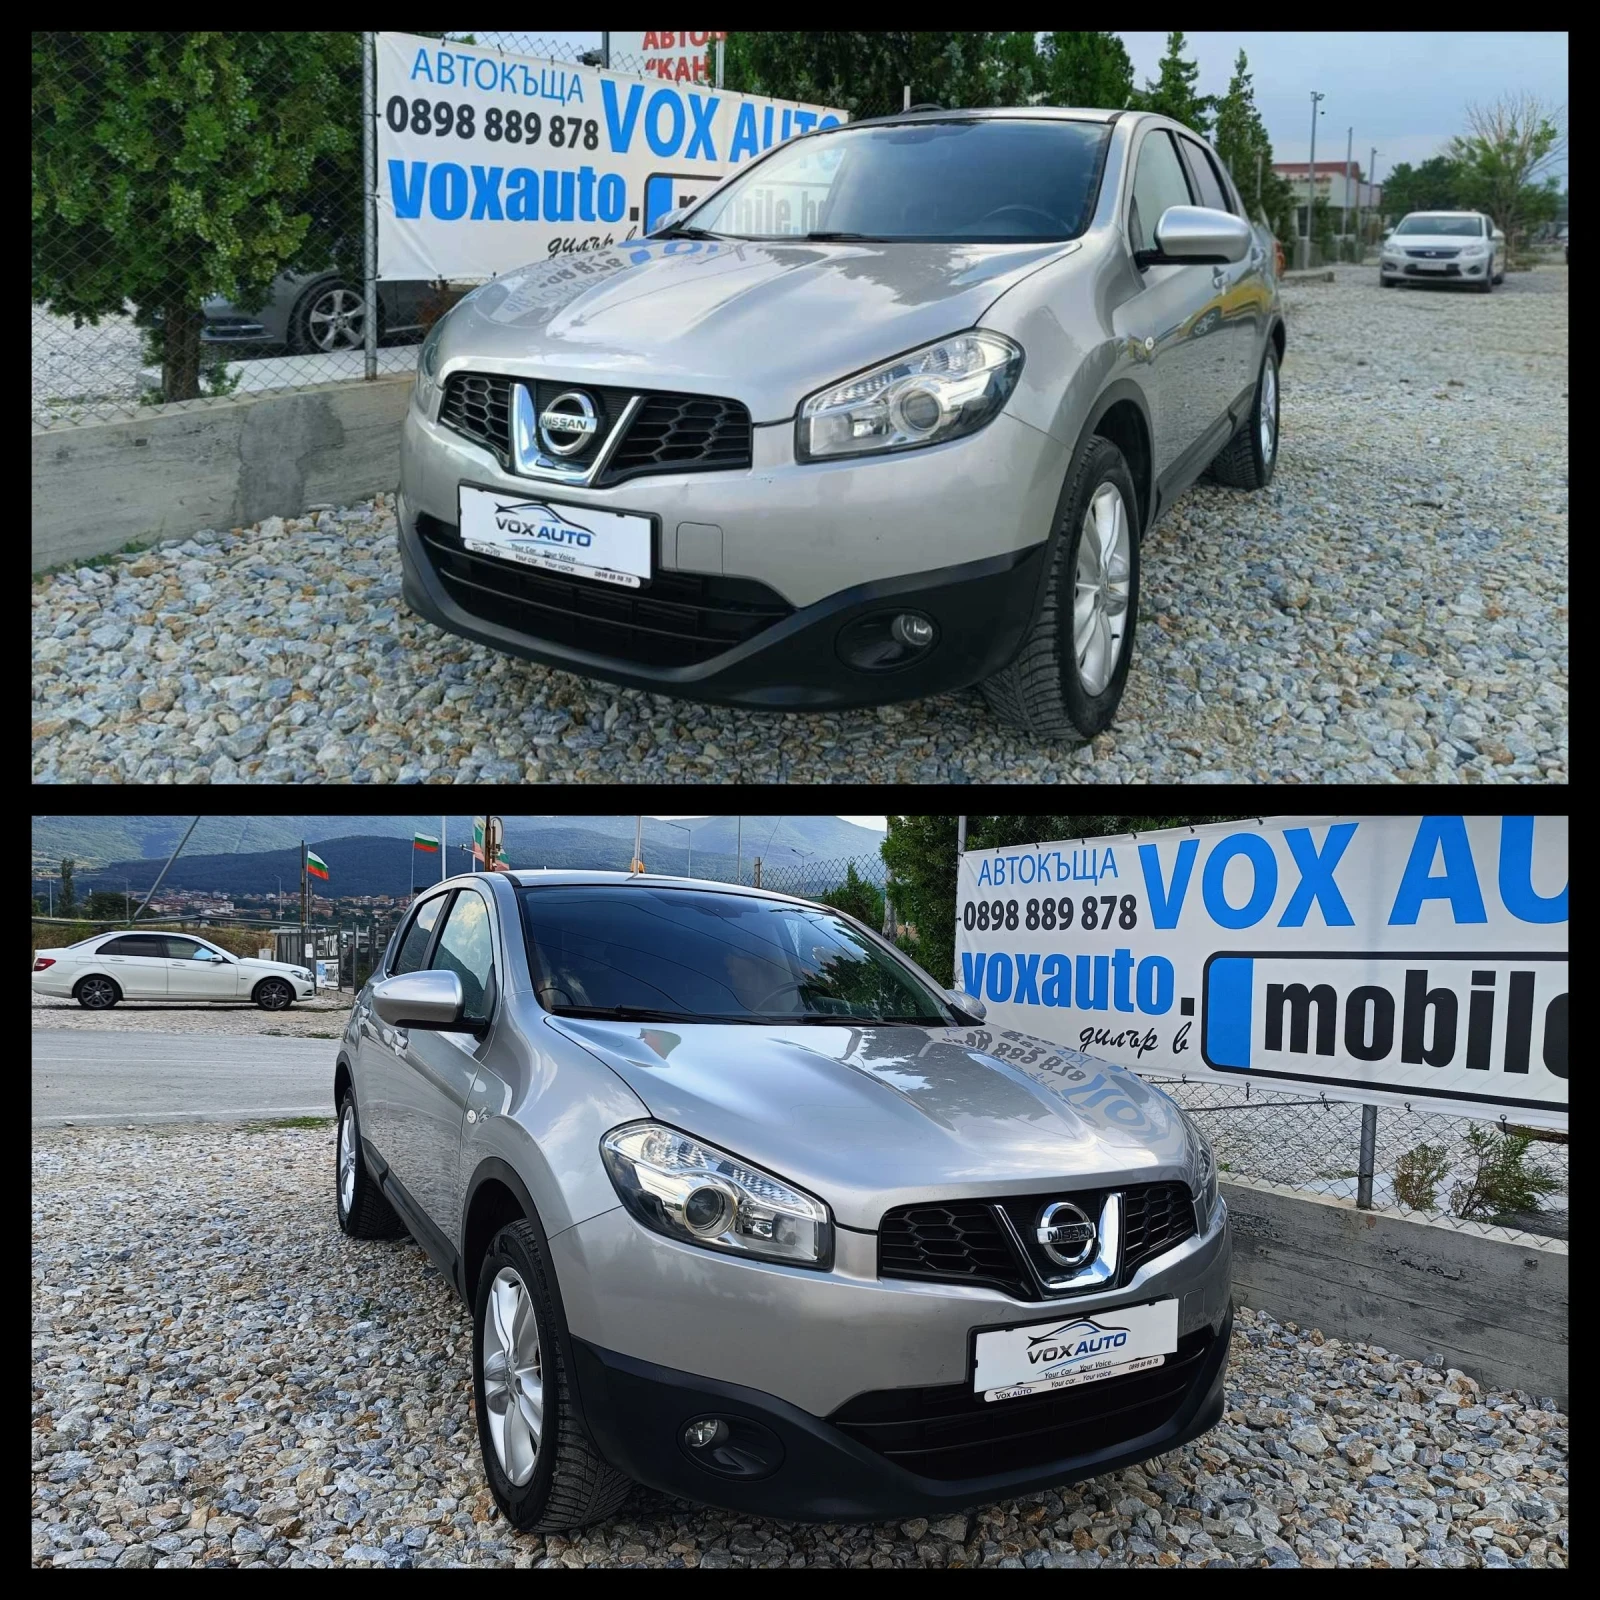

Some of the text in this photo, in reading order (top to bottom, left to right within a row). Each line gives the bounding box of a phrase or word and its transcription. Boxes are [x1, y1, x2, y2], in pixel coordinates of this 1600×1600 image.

[410, 48, 584, 106] АВТОКЪЩА
[386, 95, 599, 150] 0898 889 878
[600, 79, 720, 162] VOX
[541, 413, 587, 431] NISSAN
[495, 517, 592, 548] VOX AUTO
[977, 847, 1119, 886] АВТОКЪЩА
[1138, 822, 1360, 930] VOX
[963, 894, 1138, 932] 0898 889 878
[1079, 1025, 1159, 1059] дилър
[1047, 1225, 1094, 1243] NISSAN
[1027, 1332, 1127, 1365] VOX AUTO
[1044, 1371, 1059, 1379] Your
[1080, 1362, 1094, 1371] Your
[1051, 1380, 1065, 1388] Your
[1083, 1373, 1096, 1381] Your
[996, 1388, 1032, 1400] VOX AUTO
